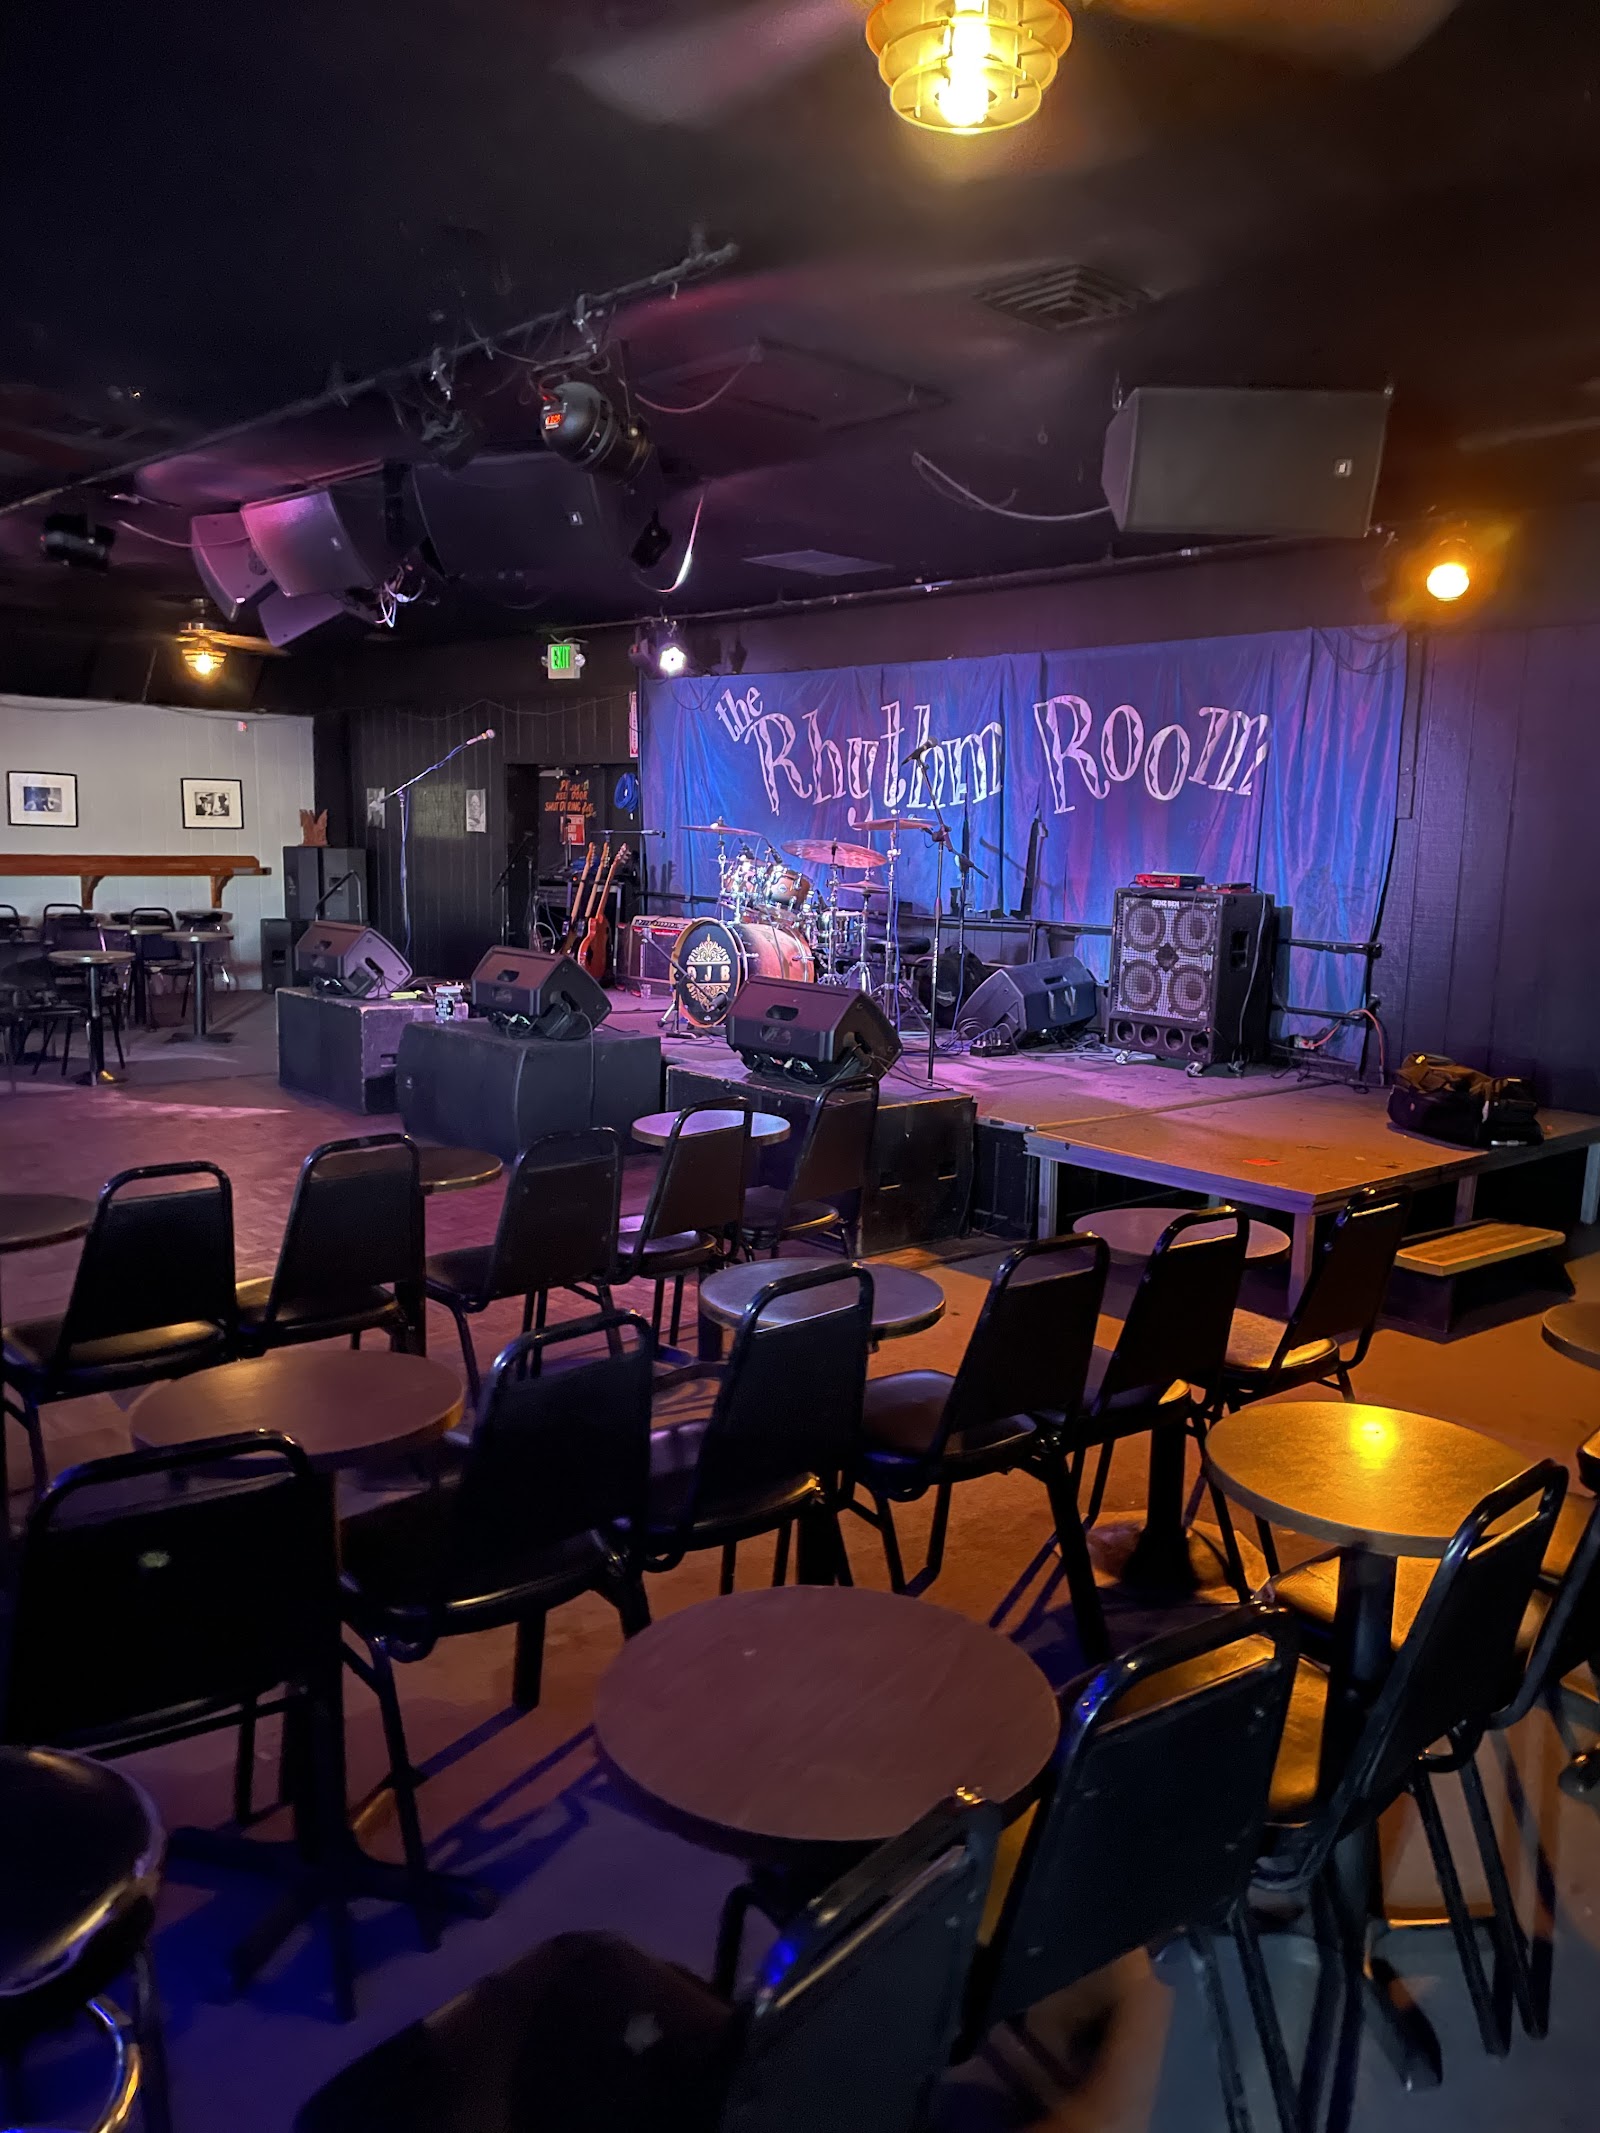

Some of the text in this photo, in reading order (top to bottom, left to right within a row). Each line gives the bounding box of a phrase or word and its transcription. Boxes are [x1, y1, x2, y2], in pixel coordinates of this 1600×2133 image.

[551, 645, 571, 669] EXIT
[715, 686, 764, 742] the
[744, 700, 1003, 832] Rhythm
